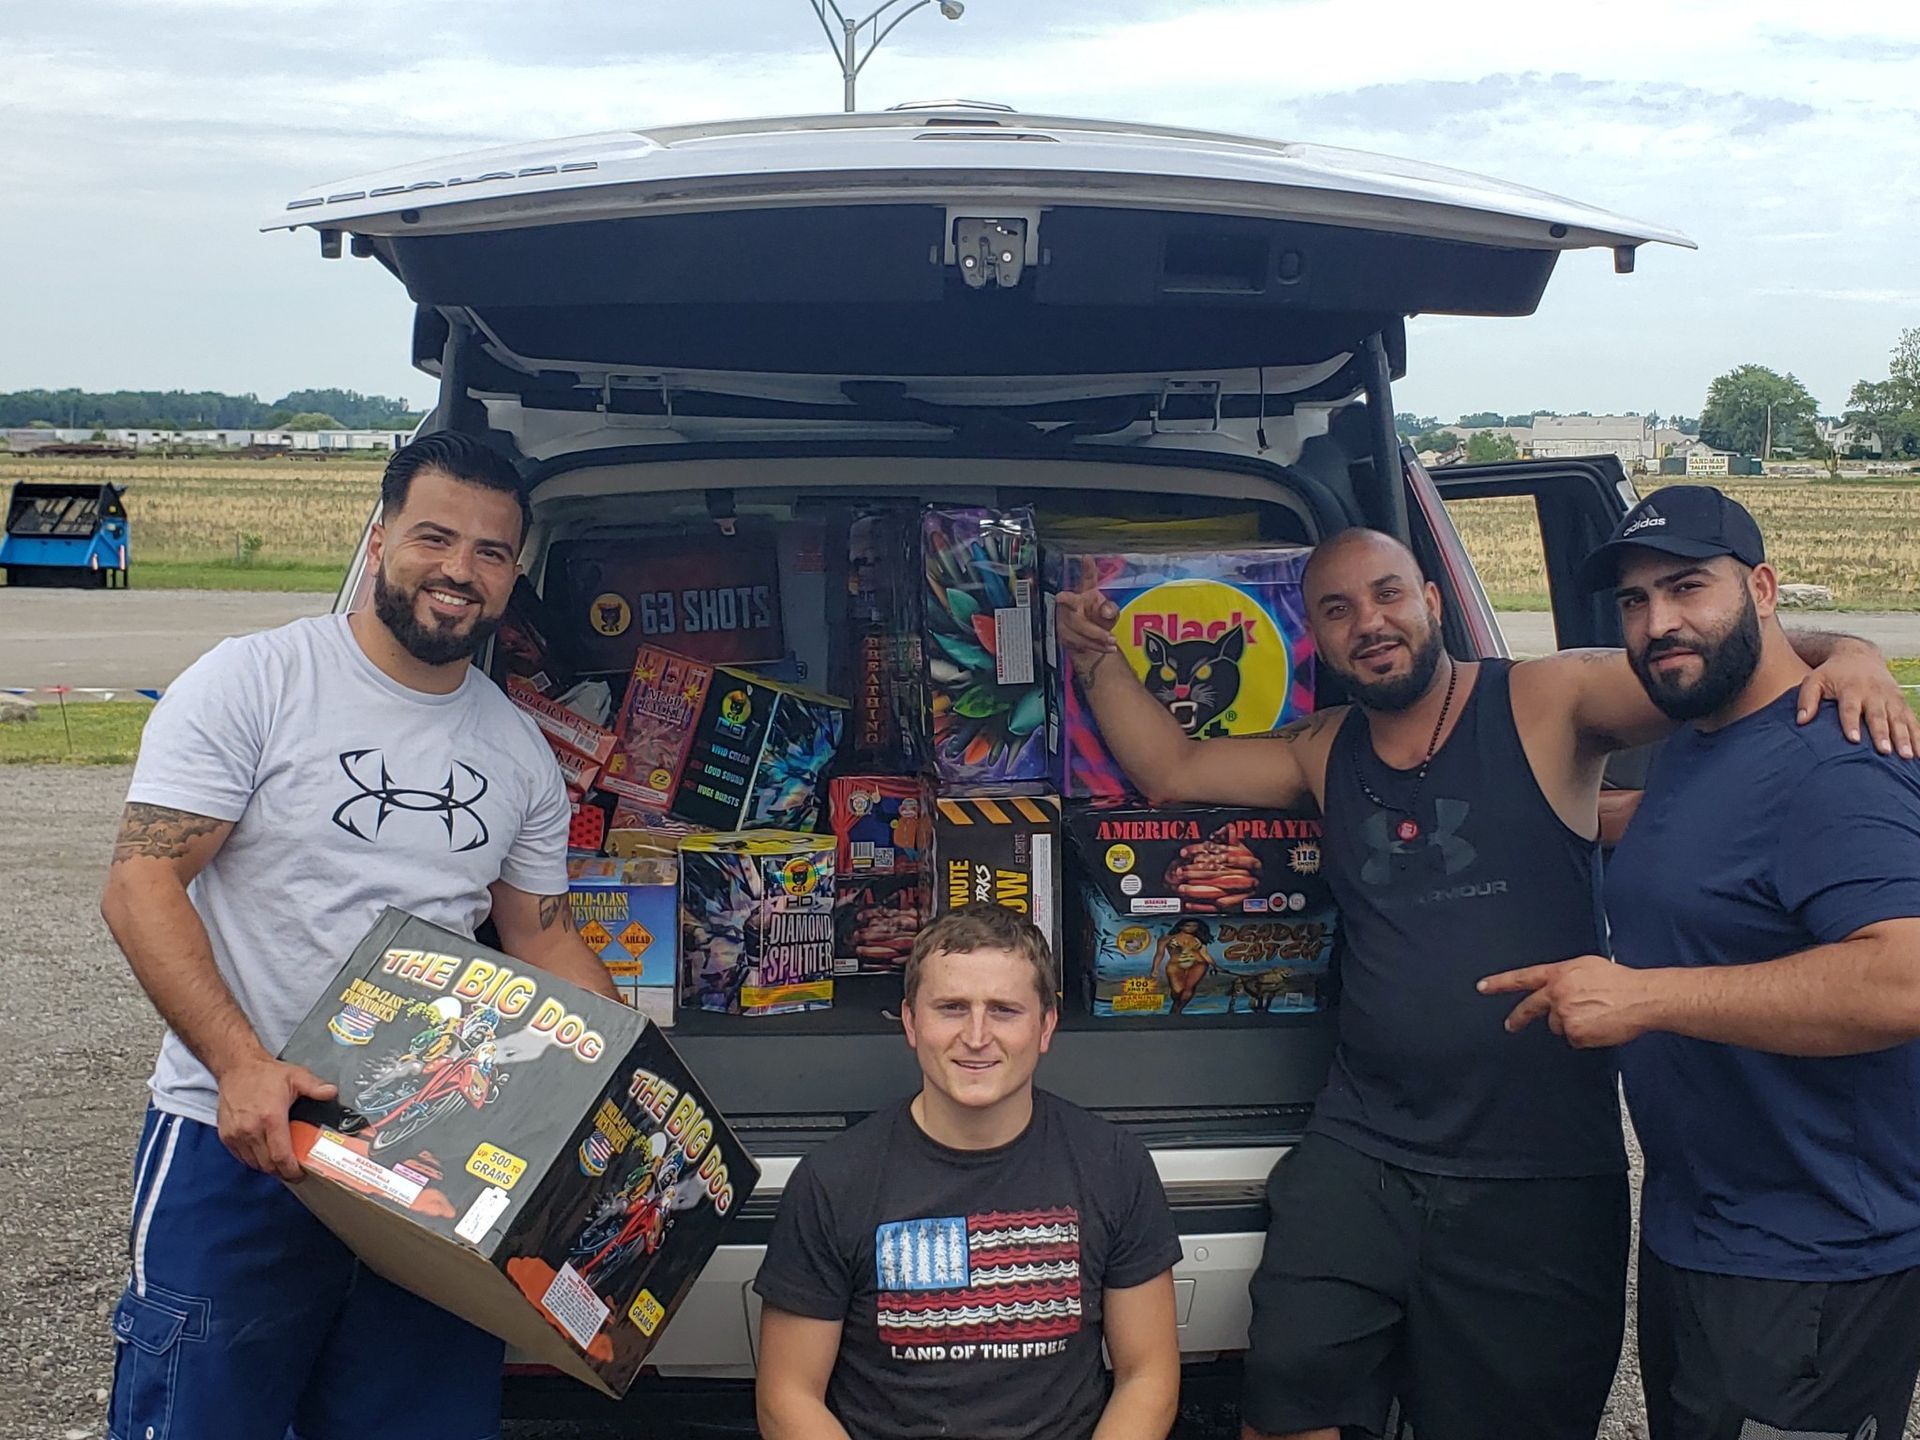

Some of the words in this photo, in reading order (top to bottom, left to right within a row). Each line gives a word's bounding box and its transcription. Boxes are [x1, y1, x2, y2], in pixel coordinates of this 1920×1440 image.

[1623, 517, 1666, 537] adidas
[640, 592, 676, 634] 63
[682, 586, 770, 633] SHOTS
[1133, 612, 1257, 647] Black
[711, 743, 728, 757] VIVID
[728, 750, 751, 765] COLOR
[654, 774, 668, 782] 72
[704, 763, 721, 777] LOUD
[721, 771, 744, 786] SOUND
[697, 784, 714, 797] HUGE
[714, 790, 740, 807] BURSTS
[1095, 821, 1200, 840] AMERICA
[1235, 819, 1325, 839] PRAYIN
[1296, 851, 1317, 861] 118
[791, 884, 806, 893] Cat
[949, 860, 969, 908] INUTE
[786, 896, 813, 907] HD
[624, 935, 651, 944] AHEAD
[769, 913, 832, 945] DIAMOND
[1217, 922, 1326, 944] DEADLY
[767, 942, 832, 983] SPLITTER
[1223, 940, 1324, 963] CATCH
[382, 949, 463, 991] THE
[452, 958, 537, 1019] BIG
[529, 996, 605, 1064] DOG
[628, 1068, 679, 1124] THE
[664, 1092, 713, 1163] BIG
[698, 1143, 734, 1216] DOG
[472, 1160, 513, 1185] GRAMS
[477, 1149, 488, 1157] UP
[489, 1152, 512, 1168] 500
[511, 1165, 521, 1174] TO
[643, 1298, 656, 1314] 500
[632, 1306, 654, 1331] GRAMS
[891, 1345, 946, 1361] LAND
[950, 1344, 977, 1360] OF
[979, 1342, 1019, 1359] THE
[1022, 1339, 1068, 1358] FREE
